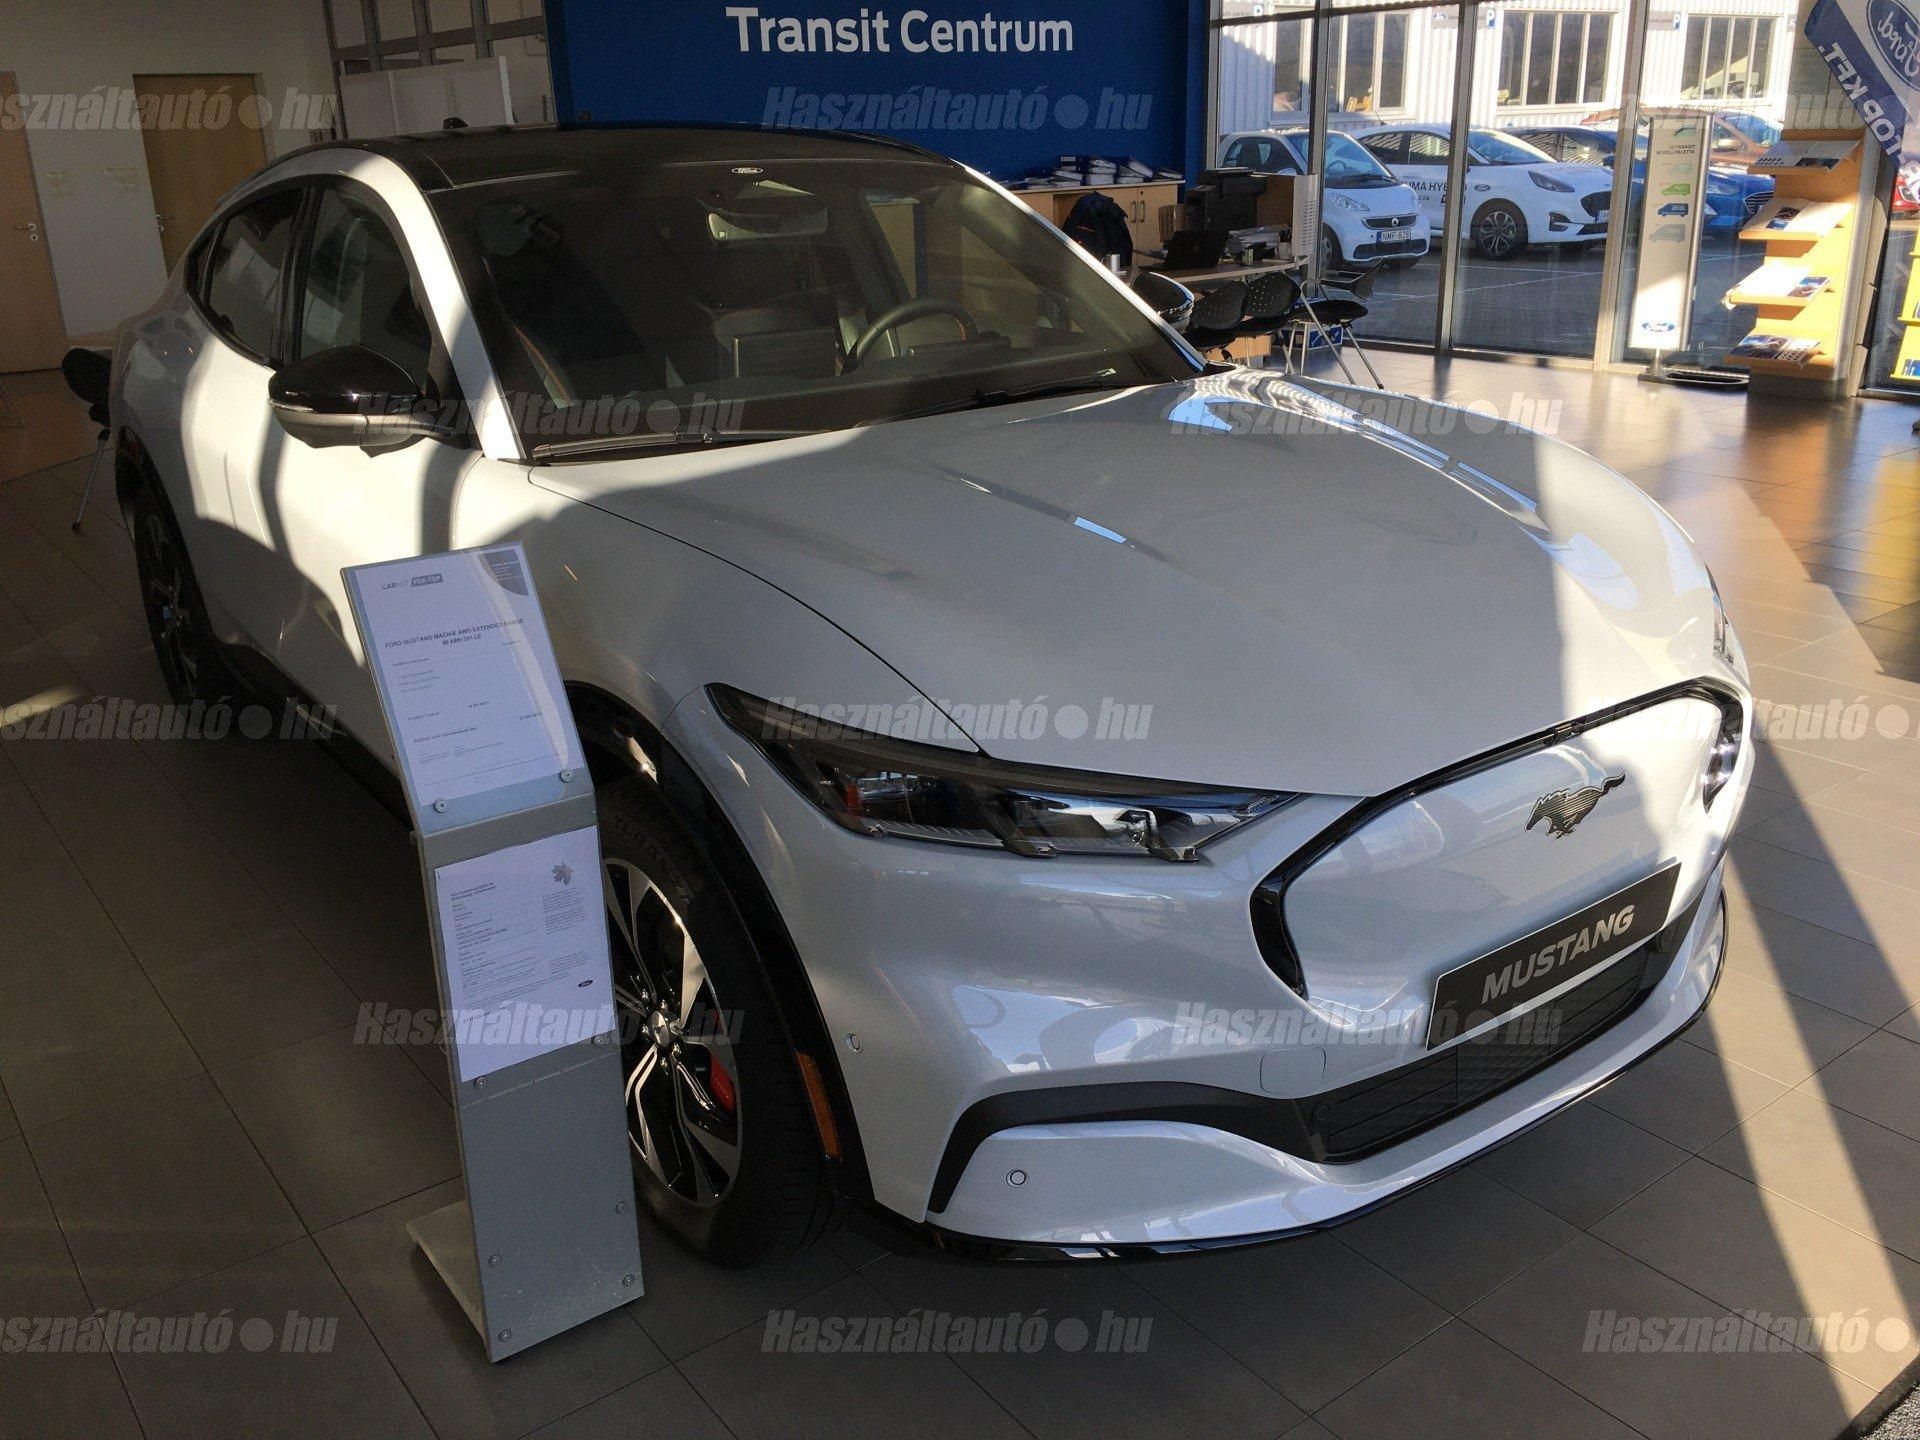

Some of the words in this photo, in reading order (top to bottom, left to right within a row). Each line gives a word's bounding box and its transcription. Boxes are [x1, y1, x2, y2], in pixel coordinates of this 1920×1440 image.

[725, 7, 890, 53] Transit
[900, 9, 1073, 53] Centrum
[385, 640, 402, 649] FORD
[403, 634, 433, 645] MUSTANG
[472, 621, 503, 632] EXTENDED
[1481, 904, 1635, 1005] MUSTANG
